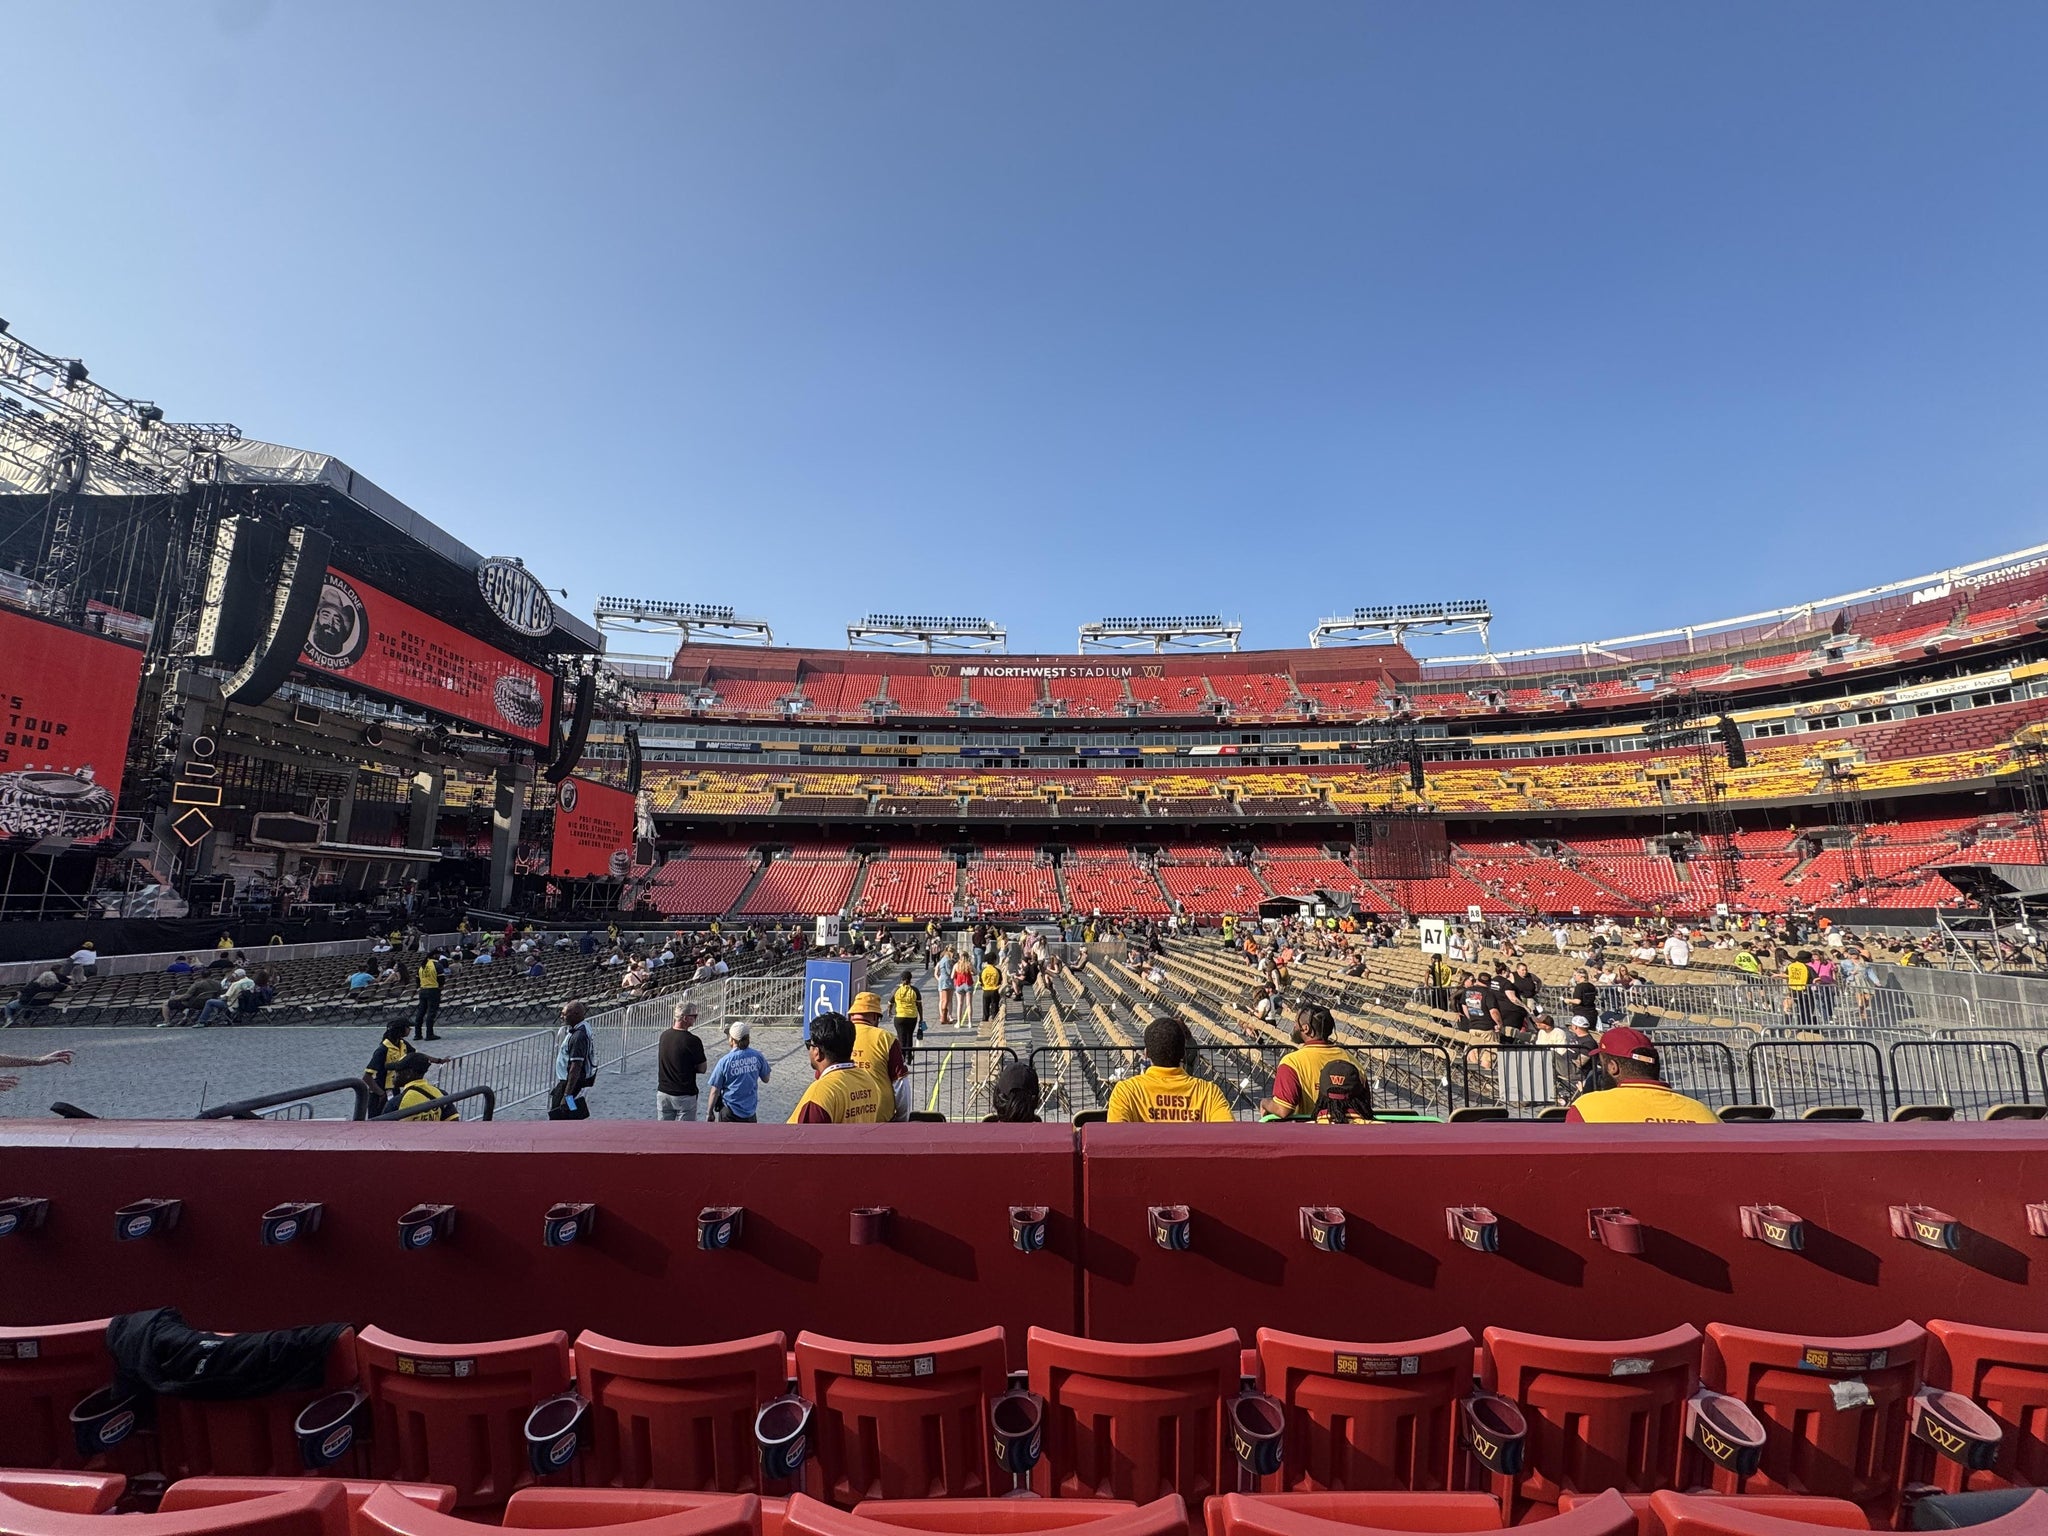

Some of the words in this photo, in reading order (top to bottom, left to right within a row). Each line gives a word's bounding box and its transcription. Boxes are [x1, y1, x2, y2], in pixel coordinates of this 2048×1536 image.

[1954, 557, 2048, 589] NORTHWEST
[330, 576, 363, 610] MALONE
[401, 630, 426, 647] POST
[303, 641, 350, 667] LANDOVER
[379, 632, 397, 646] BIG
[401, 642, 420, 656] ASS
[425, 653, 465, 675] STADIUM
[984, 667, 1067, 677] NORTHWEST
[1070, 667, 1132, 677] STADIUM
[9, 714, 68, 736] TOUR
[831, 745, 847, 753] HAIL
[953, 910, 963, 919] A3
[1470, 909, 1480, 919] A8
[826, 923, 838, 937] A2
[1424, 929, 1442, 945] A7
[731, 1056, 758, 1069] GROUND
[730, 1064, 758, 1076] CONTROL
[850, 1089, 872, 1101] GUEST
[1156, 1094, 1191, 1108] GUEST
[1148, 1107, 1200, 1121] SERVICES
[102, 1415, 134, 1437] PEPSI
[324, 1430, 352, 1452] PEPSI
